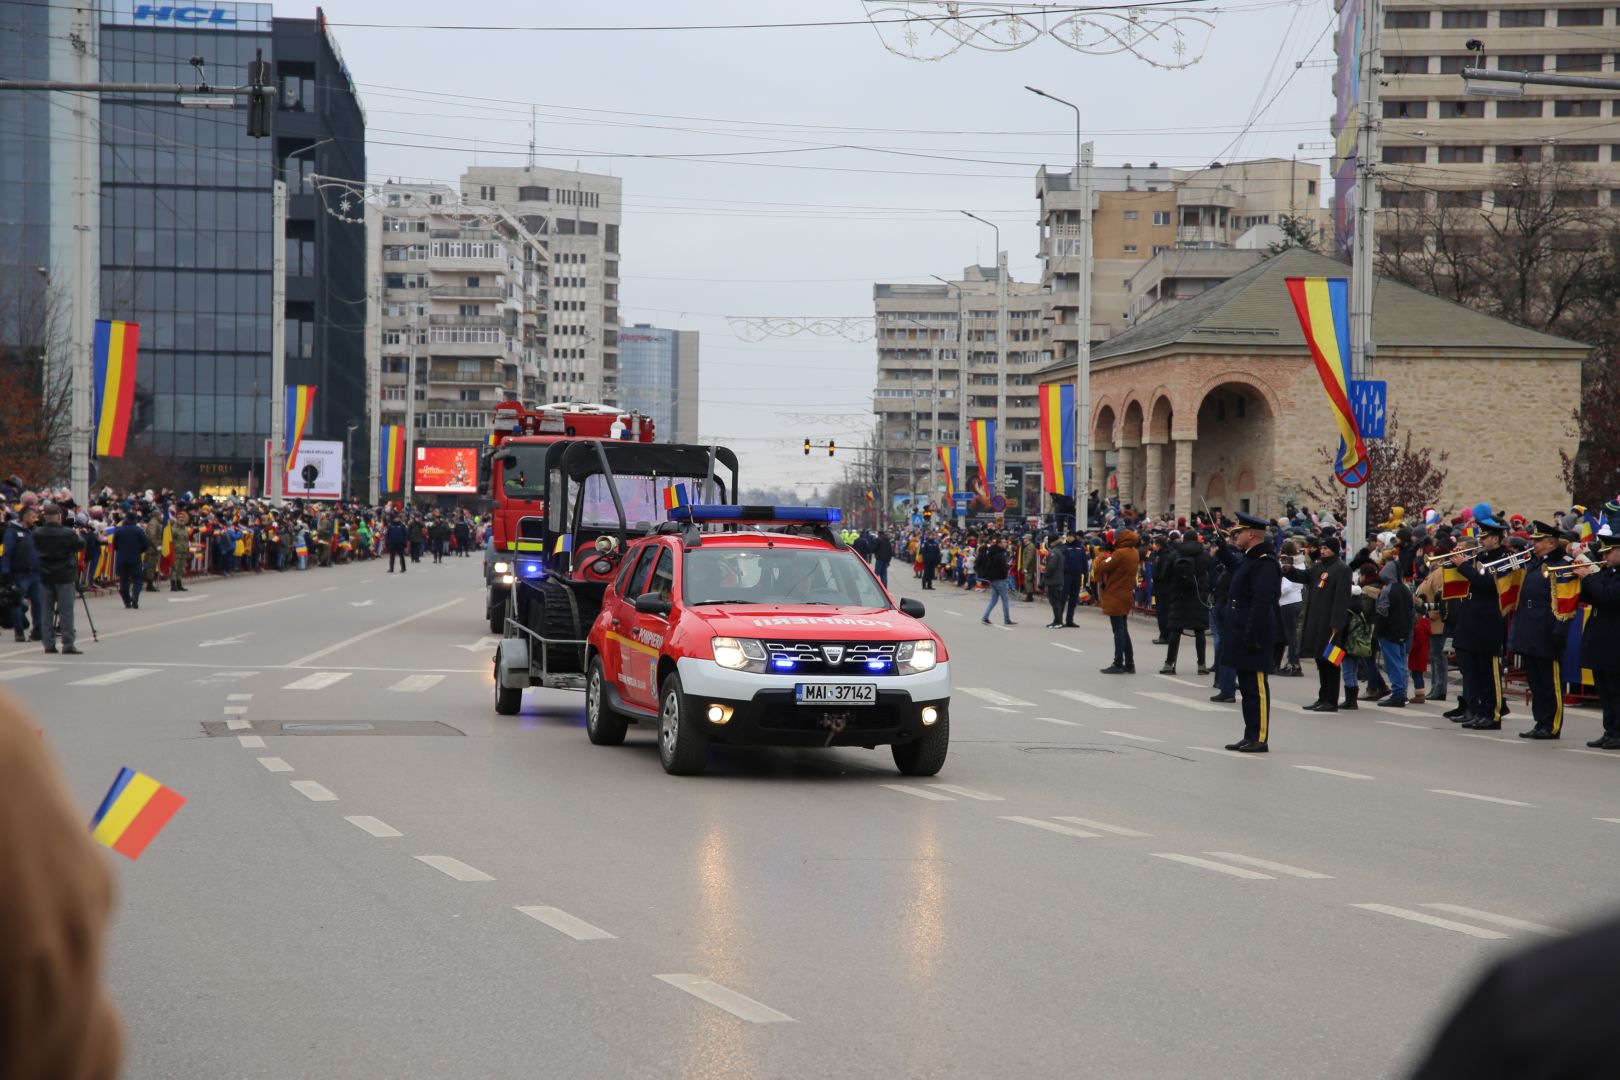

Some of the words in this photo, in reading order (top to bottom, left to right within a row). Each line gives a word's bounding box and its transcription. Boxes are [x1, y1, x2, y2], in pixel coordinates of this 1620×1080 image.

[133, 5, 237, 24] HCL
[806, 686, 826, 699] MAI
[835, 686, 872, 699] 37142
